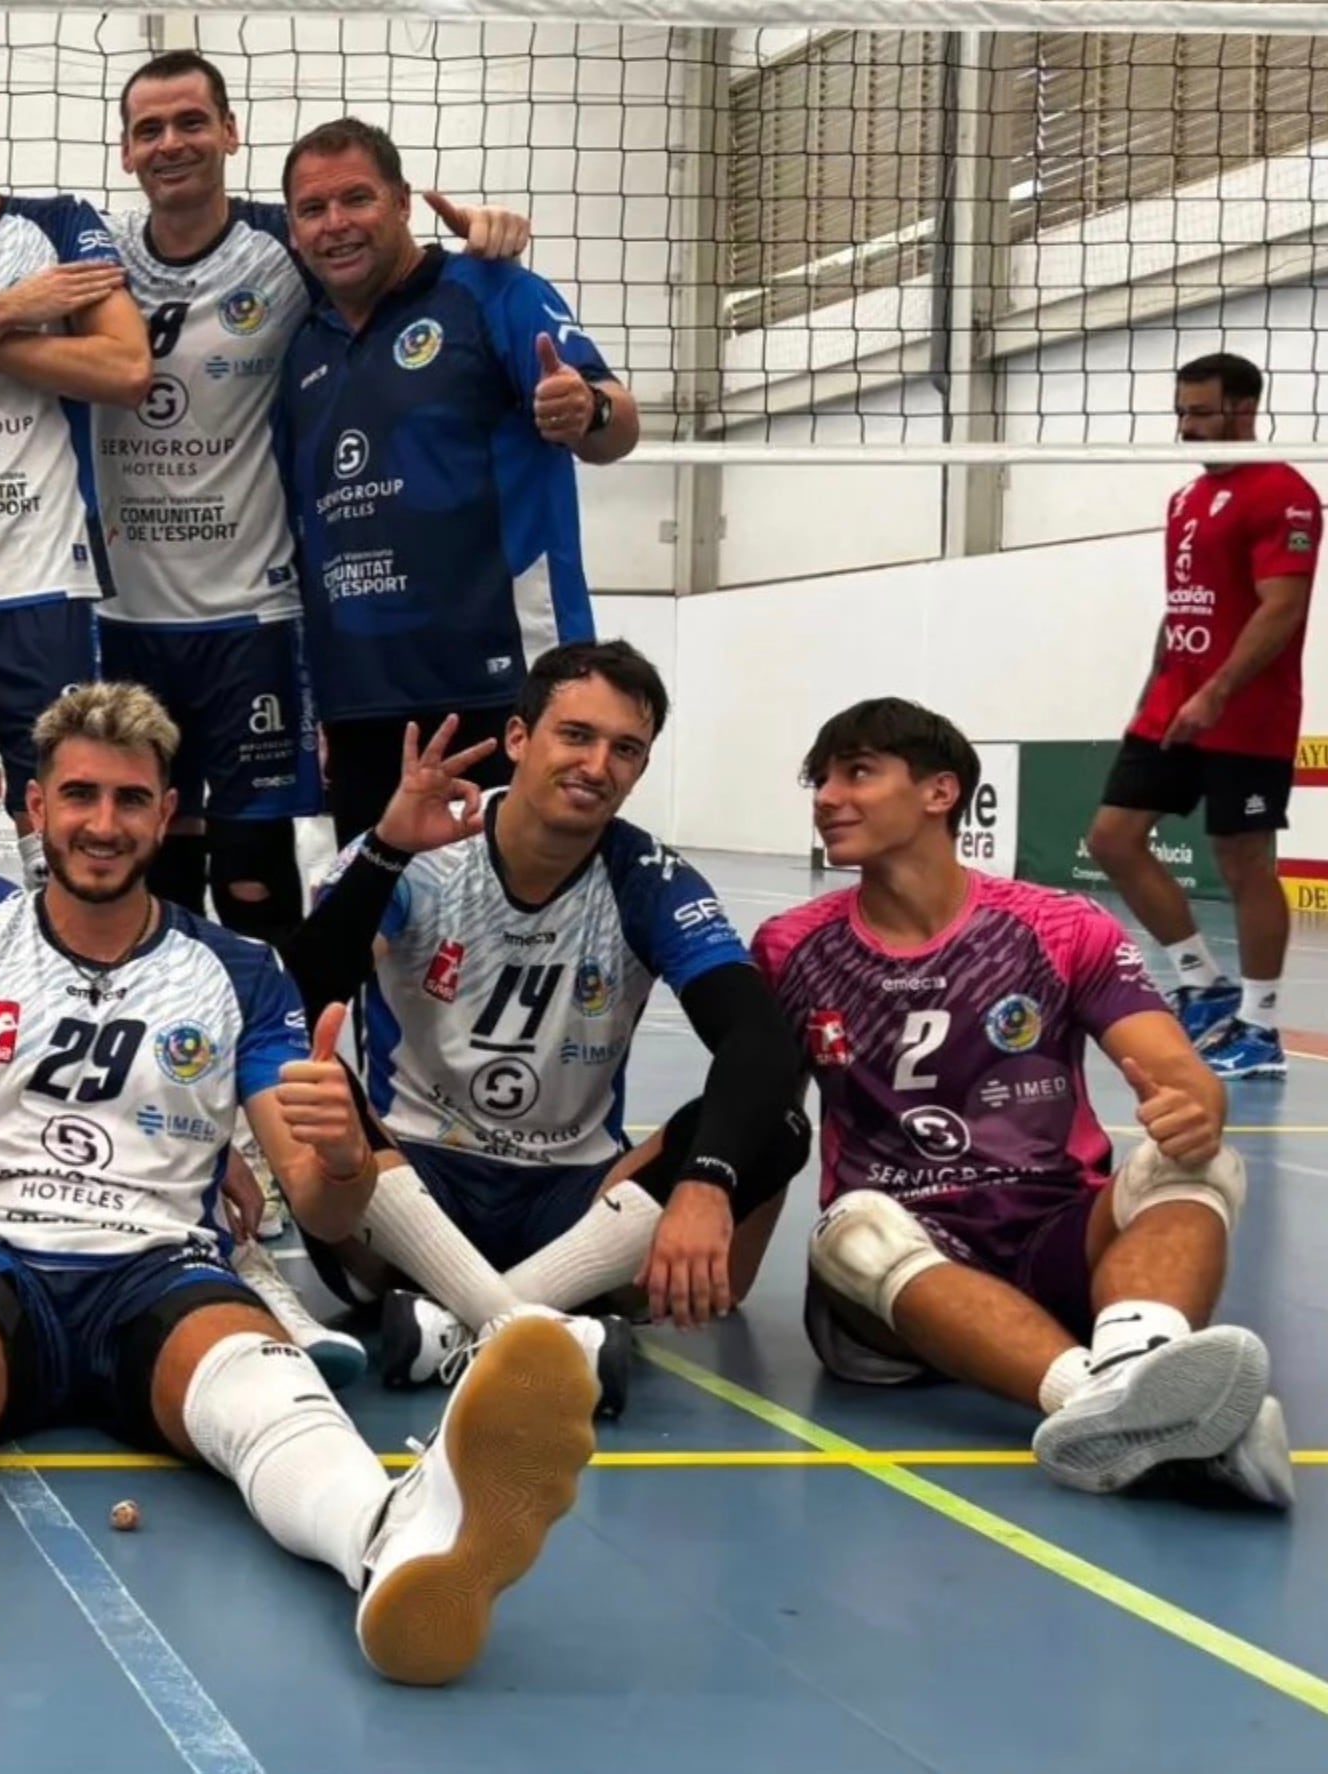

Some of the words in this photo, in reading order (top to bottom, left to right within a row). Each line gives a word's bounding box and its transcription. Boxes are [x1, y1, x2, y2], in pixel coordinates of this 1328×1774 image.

[101, 437, 235, 457] SERVIGROUP
[122, 462, 198, 477] HOTELES
[120, 505, 225, 525] COMUNITAT
[128, 524, 147, 542] DE
[151, 522, 239, 542] L'ESPORT
[470, 963, 566, 1041] 14
[25, 1016, 147, 1104] 29
[893, 1008, 951, 1091] 2
[1014, 1076, 1067, 1097] IMED
[19, 1181, 126, 1212] HOTELES
